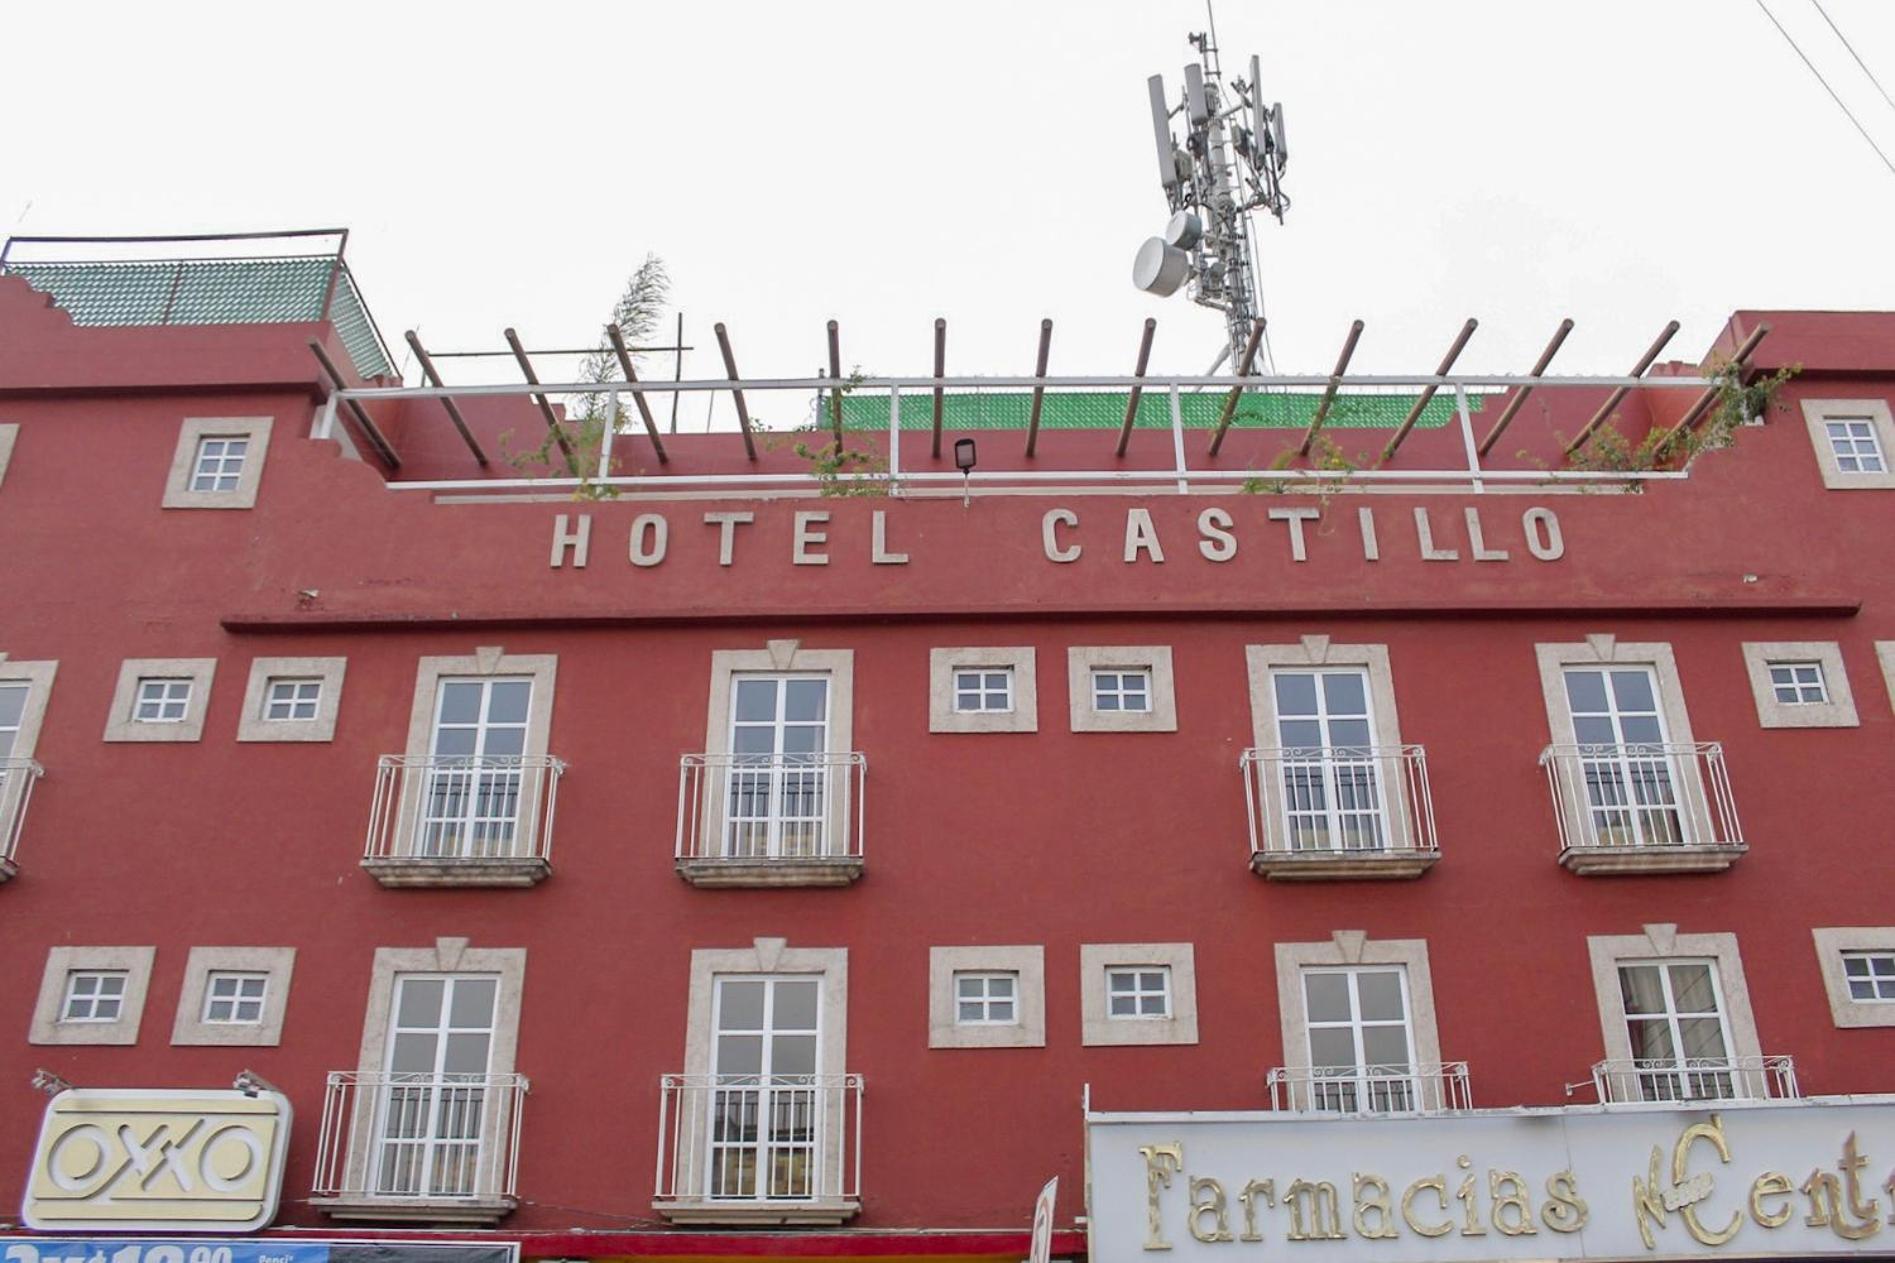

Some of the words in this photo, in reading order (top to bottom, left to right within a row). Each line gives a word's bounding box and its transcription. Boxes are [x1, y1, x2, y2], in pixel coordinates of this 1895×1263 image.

[550, 510, 909, 567] HOTEL
[1041, 506, 1566, 563] CASTILLO
[47, 1118, 266, 1196] OXXO
[1138, 1140, 1589, 1251] Farmacias
